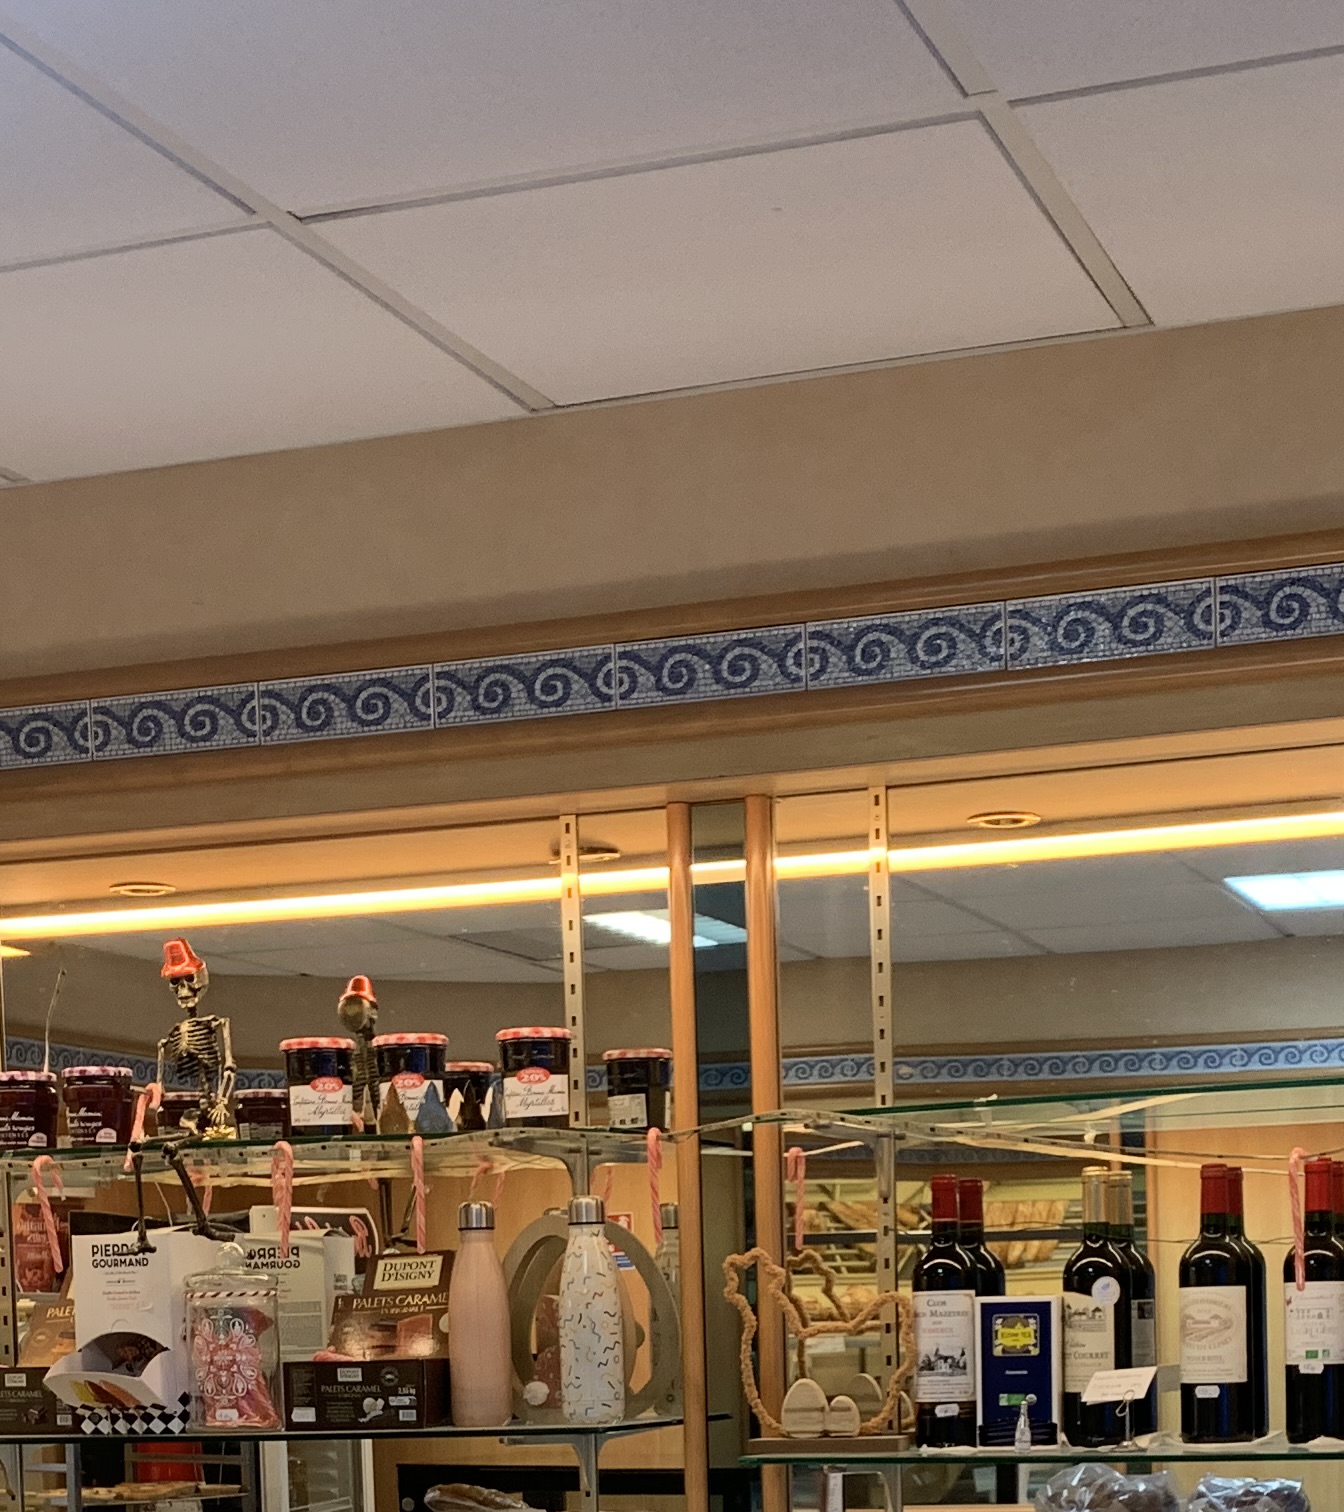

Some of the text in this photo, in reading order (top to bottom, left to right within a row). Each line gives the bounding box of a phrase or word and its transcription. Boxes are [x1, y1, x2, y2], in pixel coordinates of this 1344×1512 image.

[91, 1257, 149, 1269] GOURMAND
[383, 1260, 436, 1272] DUPONT
[381, 1270, 435, 1282] D'ISIGNY
[352, 1296, 394, 1309] PALETS
[320, 1384, 382, 1393] PALETS CARAMEL
